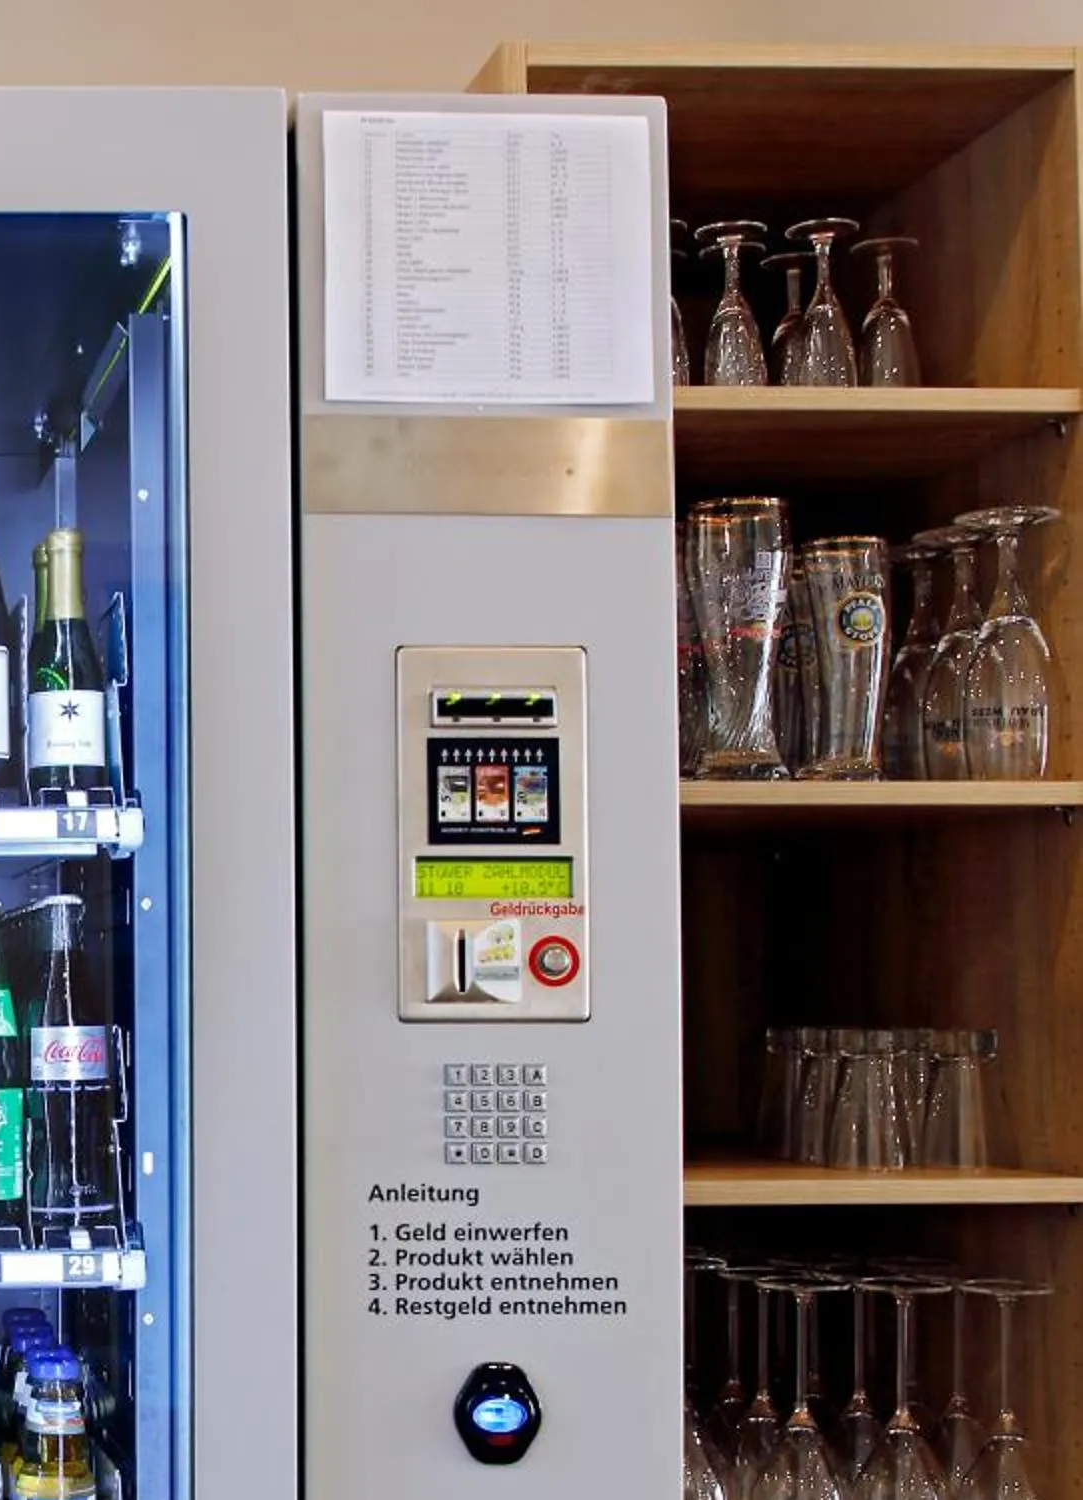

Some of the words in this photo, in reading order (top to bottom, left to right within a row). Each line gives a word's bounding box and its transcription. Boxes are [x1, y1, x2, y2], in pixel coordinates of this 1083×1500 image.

[64, 812, 88, 830] 17
[481, 1069, 489, 1081] 2
[507, 1069, 515, 1081] 3
[532, 1069, 542, 1081] A
[506, 1095, 516, 1107] 6
[532, 1095, 542, 1107] B
[454, 1121, 463, 1132] 7
[480, 1121, 489, 1133] 8
[507, 1121, 516, 1133] 9
[532, 1121, 543, 1133] C
[532, 1147, 543, 1159] D
[369, 1184, 480, 1206] Anleitung
[370, 1224, 387, 1241] 1.
[395, 1222, 446, 1241] Geld
[454, 1222, 569, 1241] einwerfen
[69, 1255, 94, 1275] 29
[369, 1249, 387, 1266] 2.
[395, 1248, 484, 1266] Produkt
[491, 1248, 574, 1266] wählen
[369, 1273, 387, 1291] 3.
[395, 1272, 484, 1291] Produkt
[490, 1272, 619, 1291] entnehmen
[368, 1298, 387, 1315] 4.
[395, 1297, 491, 1319] Restgeld
[499, 1297, 628, 1315] entnehmen
